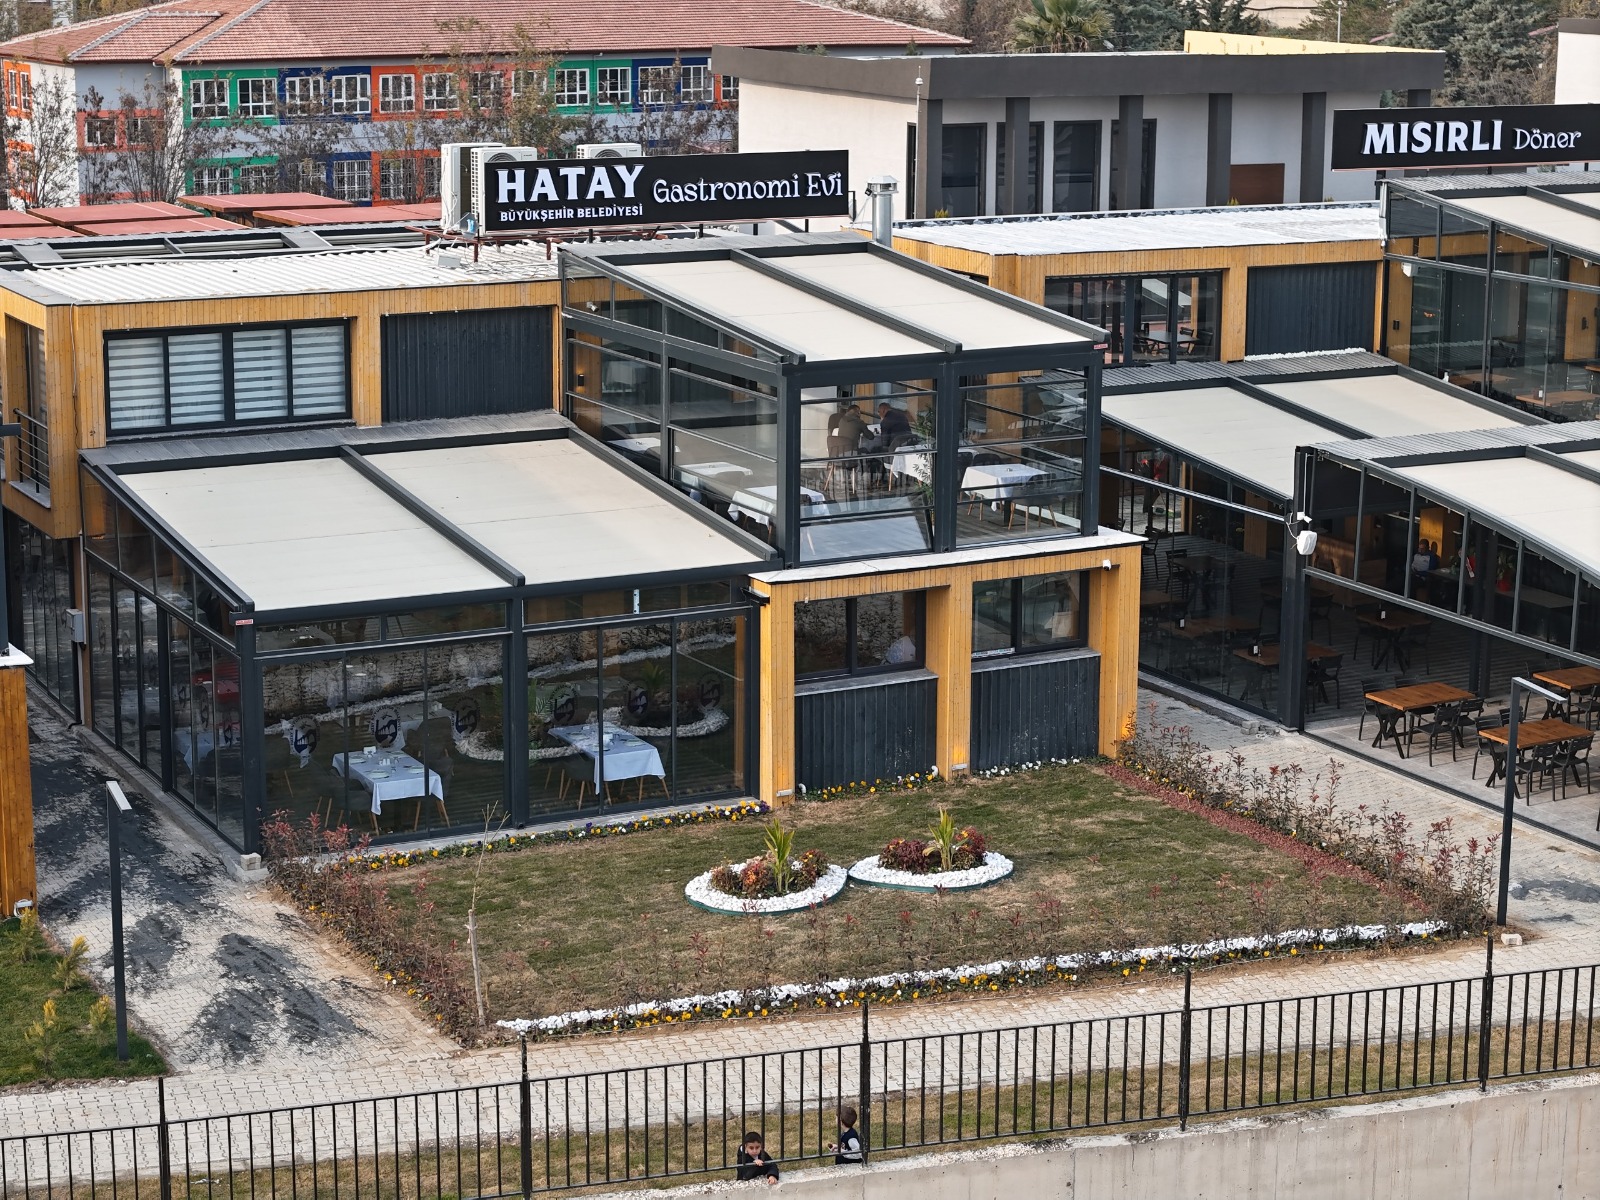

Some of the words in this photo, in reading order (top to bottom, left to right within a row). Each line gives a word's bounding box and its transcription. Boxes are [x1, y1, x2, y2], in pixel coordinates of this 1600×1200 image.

[1362, 119, 1503, 155] MISIRLI
[1512, 127, 1582, 150] Döner
[495, 164, 645, 204] HATAY
[653, 173, 801, 203] Gastronomi
[804, 171, 844, 197] Evi
[499, 205, 574, 222] BÜYÜKŞEHİR
[577, 203, 643, 219] BELEDİYESİ
